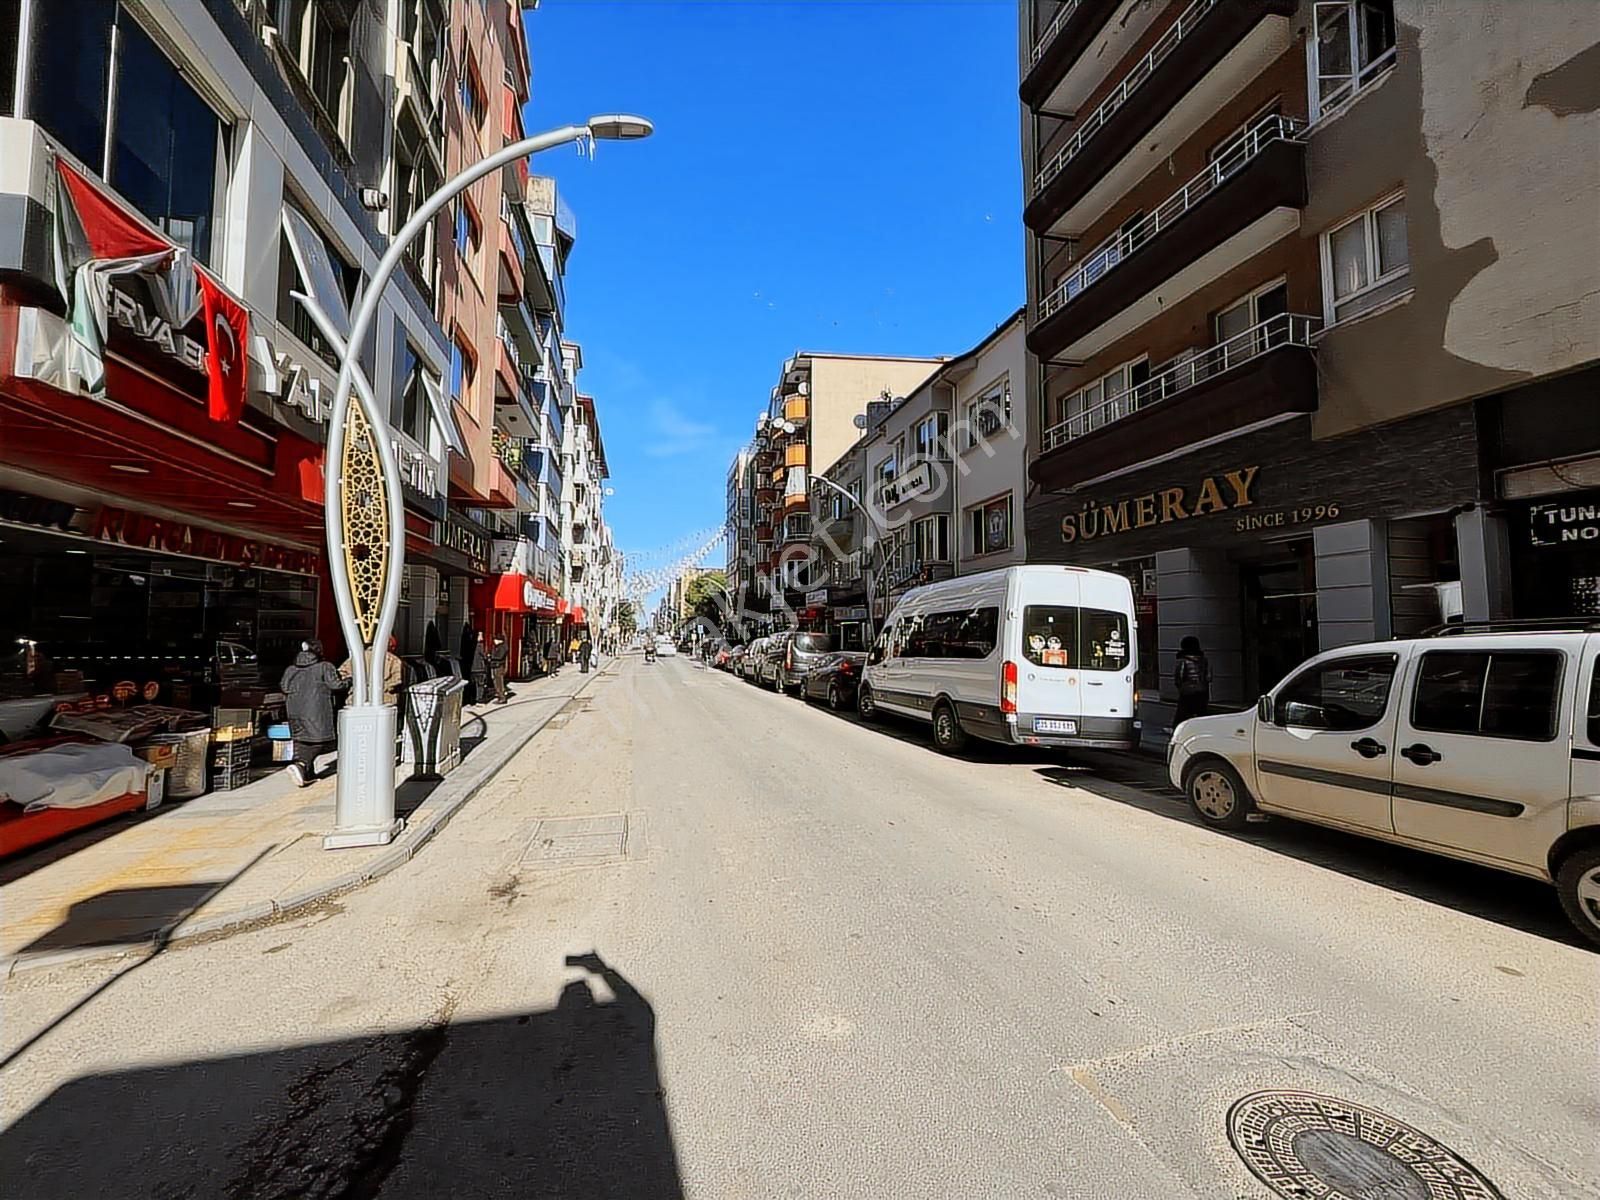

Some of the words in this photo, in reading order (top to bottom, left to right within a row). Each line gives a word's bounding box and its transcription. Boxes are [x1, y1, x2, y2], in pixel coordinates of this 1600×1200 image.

[1061, 466, 1259, 543] SÜMERAY
[1291, 502, 1340, 523] 1996
[1544, 504, 1600, 526] TUN
